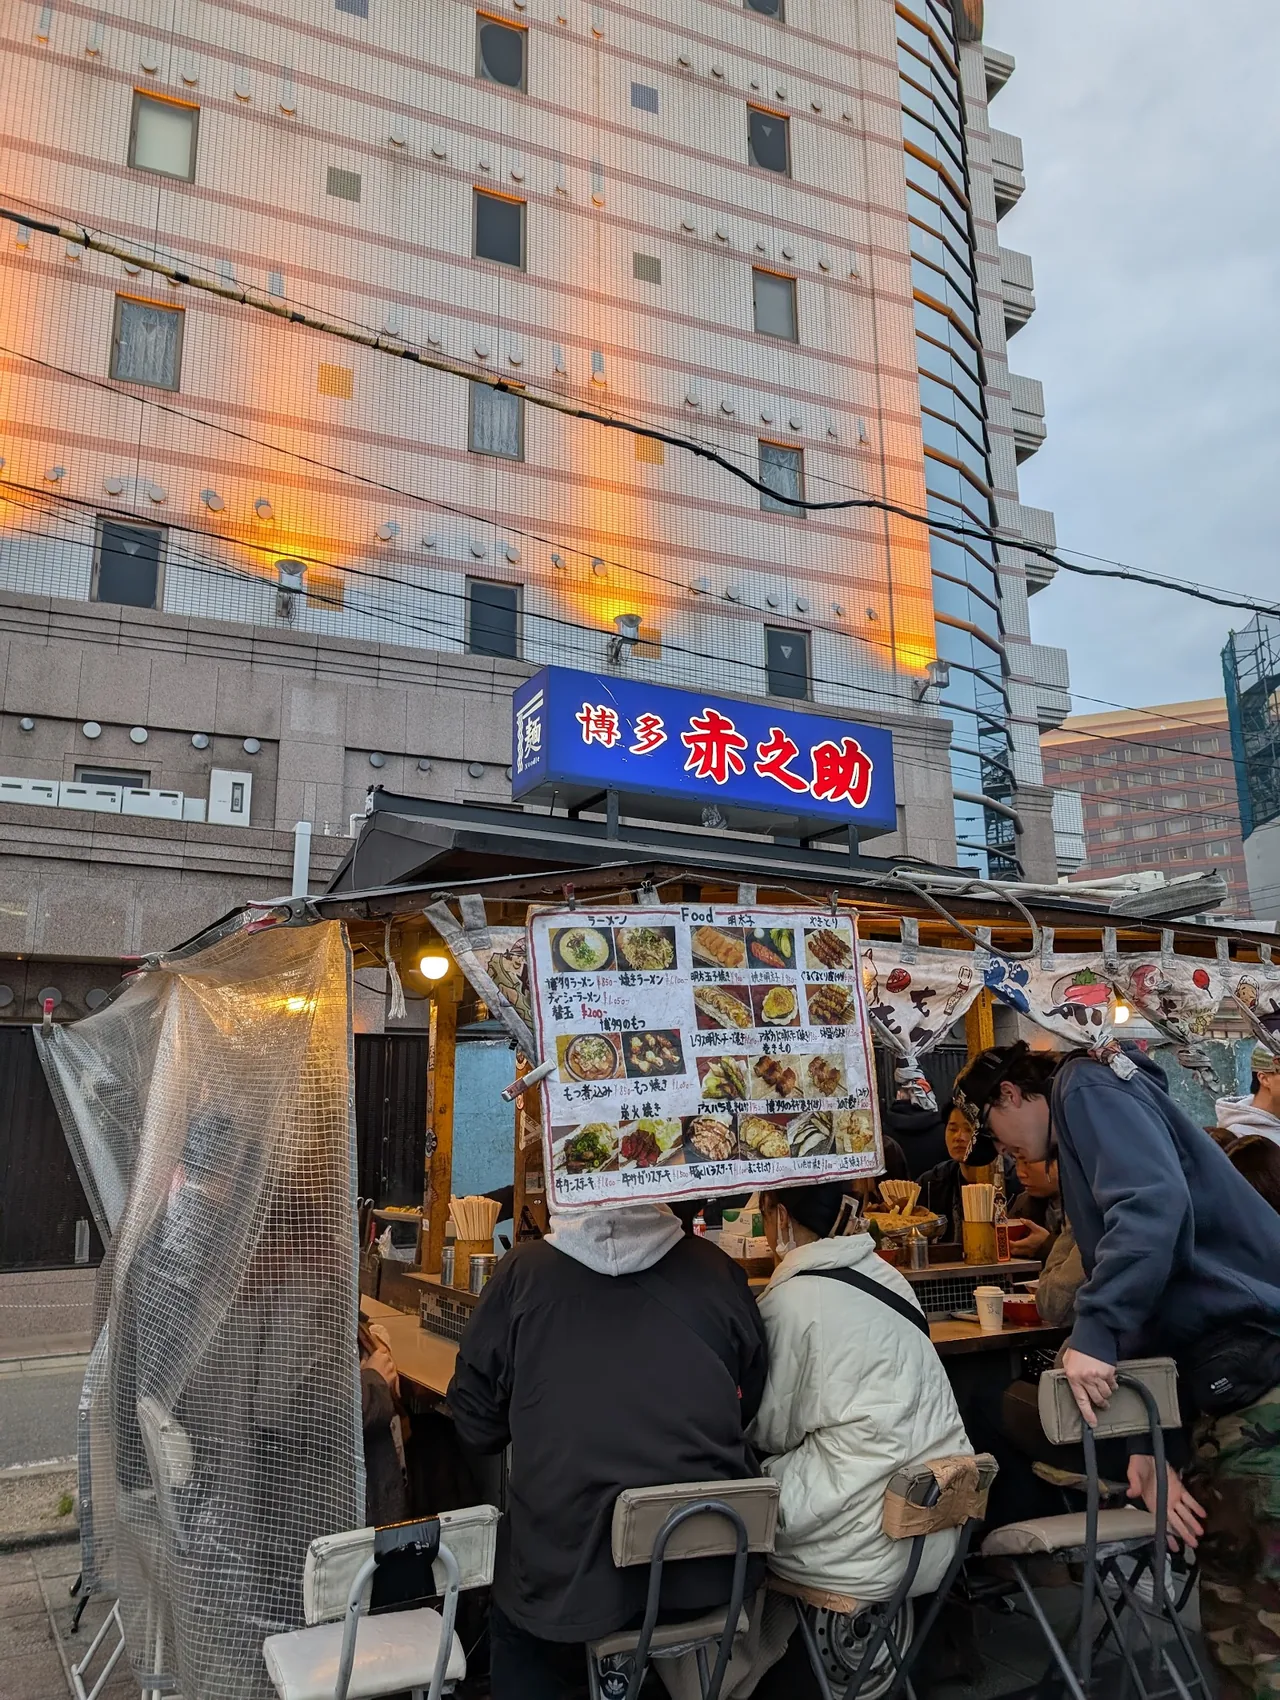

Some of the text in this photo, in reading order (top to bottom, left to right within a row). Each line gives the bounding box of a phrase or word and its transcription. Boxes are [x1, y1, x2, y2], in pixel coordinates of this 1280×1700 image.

[576, 702, 873, 808] 博多赤之助
[588, 916, 628, 926] ラーメン
[681, 907, 714, 923] Food
[728, 916, 755, 926] 明太子
[546, 976, 594, 991] 博多ラーメン
[618, 974, 664, 987] 焼きラーメン
[552, 1005, 574, 1020] 替玉
[600, 1016, 646, 1032] 博多のもつ
[762, 1043, 791, 1054] 巻きもの
[564, 1084, 612, 1101] もつ煮込み
[634, 1078, 668, 1095] もつ焼き
[620, 1102, 661, 1120] 炭火焼き
[556, 1176, 594, 1194] 牛タンステーキ
[622, 1169, 672, 1187] 牛サガリステーキ
